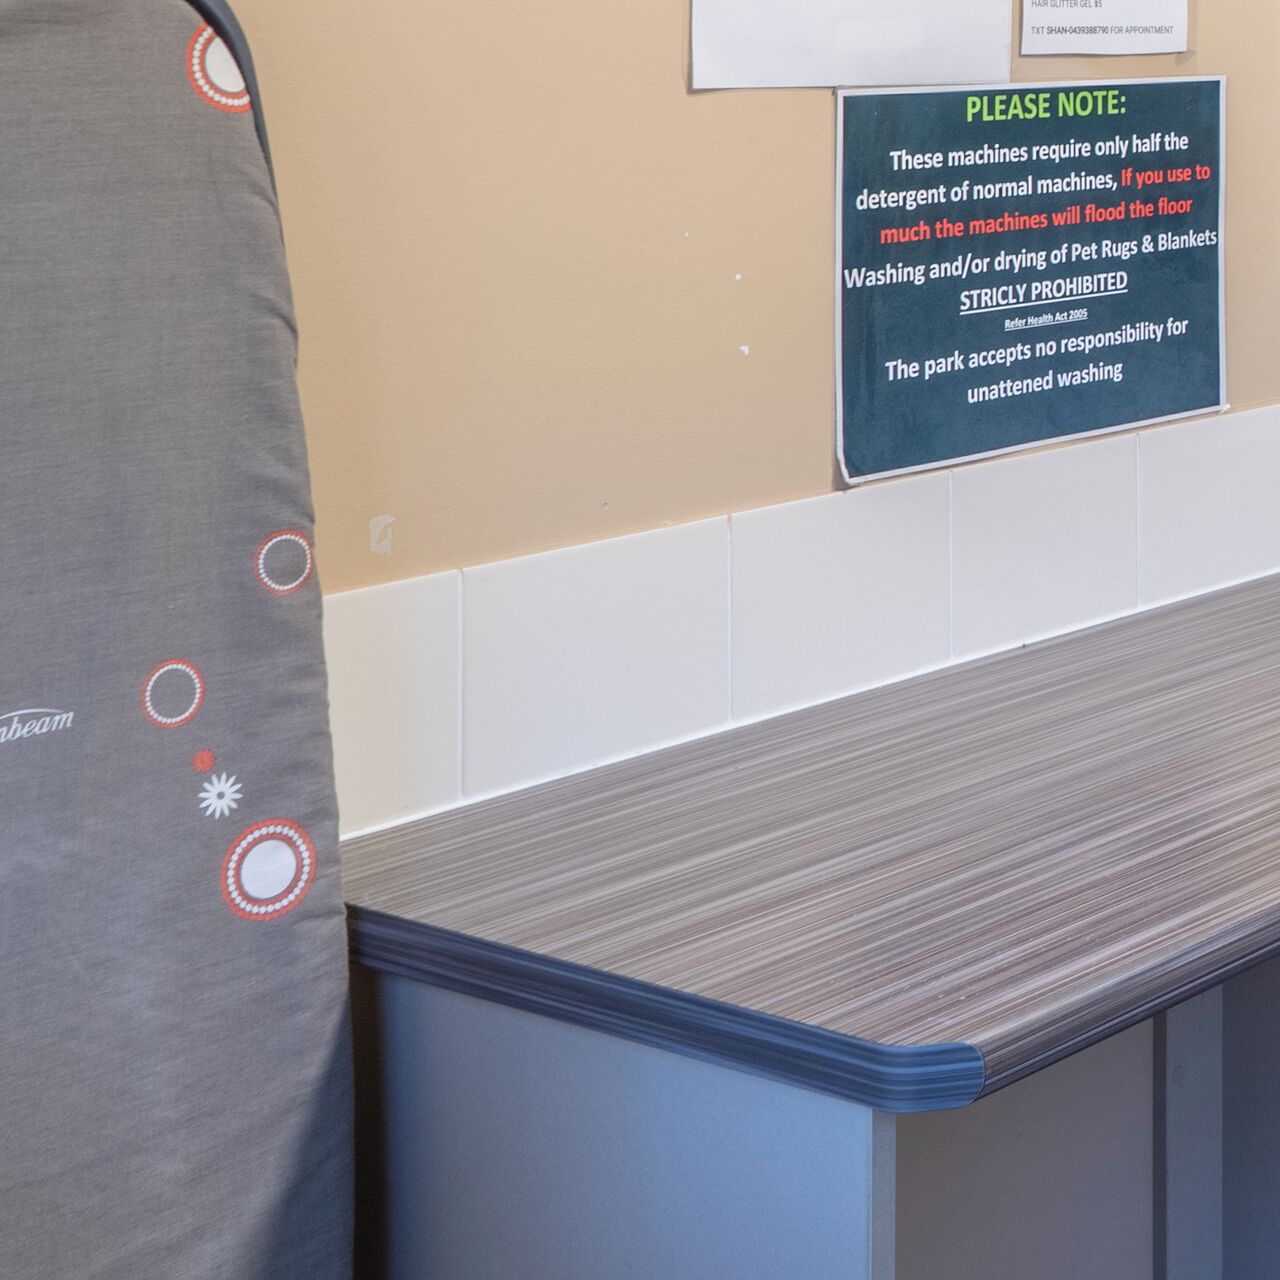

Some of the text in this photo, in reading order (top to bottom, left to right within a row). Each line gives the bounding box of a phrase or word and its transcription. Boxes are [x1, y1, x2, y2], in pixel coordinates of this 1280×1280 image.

[1050, 0, 1078, 8] GLITTER
[1080, 0, 1092, 8] GEL
[1095, 0, 1102, 8] $5
[1125, 26, 1173, 34] APPOINTMENT
[967, 90, 1126, 122] PLEASE NOTE:
[890, 132, 1188, 171] These machines require only half the
[856, 164, 1210, 210] detergent of normal machines, If you use to
[880, 197, 1192, 244] much the machines will flood the floor
[844, 229, 1217, 288] Washing and/or drying of Pet Rugs & Blankets
[960, 271, 1128, 310] STRICLY PROHIBITED
[1005, 309, 1088, 330] Refer Health Act 2005
[885, 318, 1188, 381] The park accepts no responsibility for
[968, 362, 1122, 403] unattened washing
